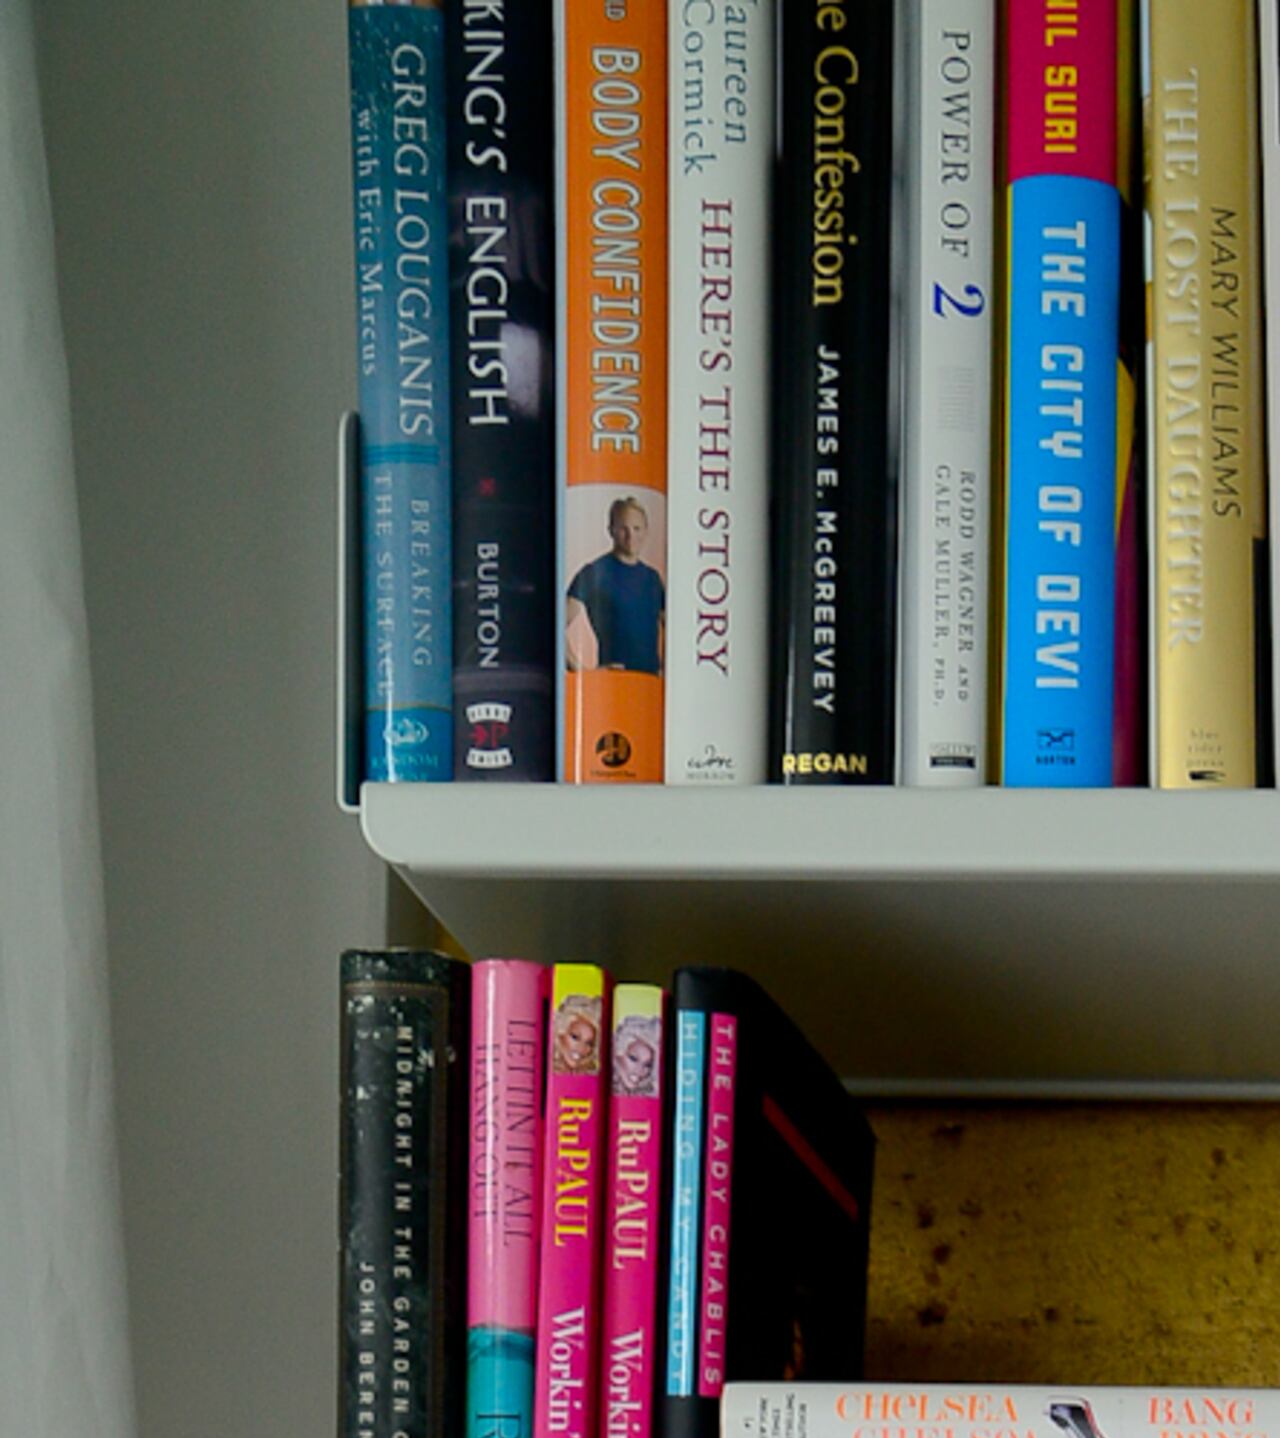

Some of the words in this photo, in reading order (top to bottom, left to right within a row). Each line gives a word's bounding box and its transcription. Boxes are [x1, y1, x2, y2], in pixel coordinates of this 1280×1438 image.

[591, 47, 642, 172] BODY
[591, 184, 642, 455] CONFIDENCE
[699, 198, 735, 375] HERE'S
[1041, 222, 1086, 316] THE
[699, 392, 733, 494] THE
[816, 345, 841, 455] JAMES
[1039, 348, 1085, 461] CITY
[816, 469, 839, 500] E.
[1038, 492, 1082, 545] OF
[696, 509, 730, 678] STORY
[811, 511, 839, 714] McGREEVEY
[1035, 572, 1080, 691] DEVI
[783, 752, 868, 776] REGAN
[552, 1099, 592, 1248] RuPAUL
